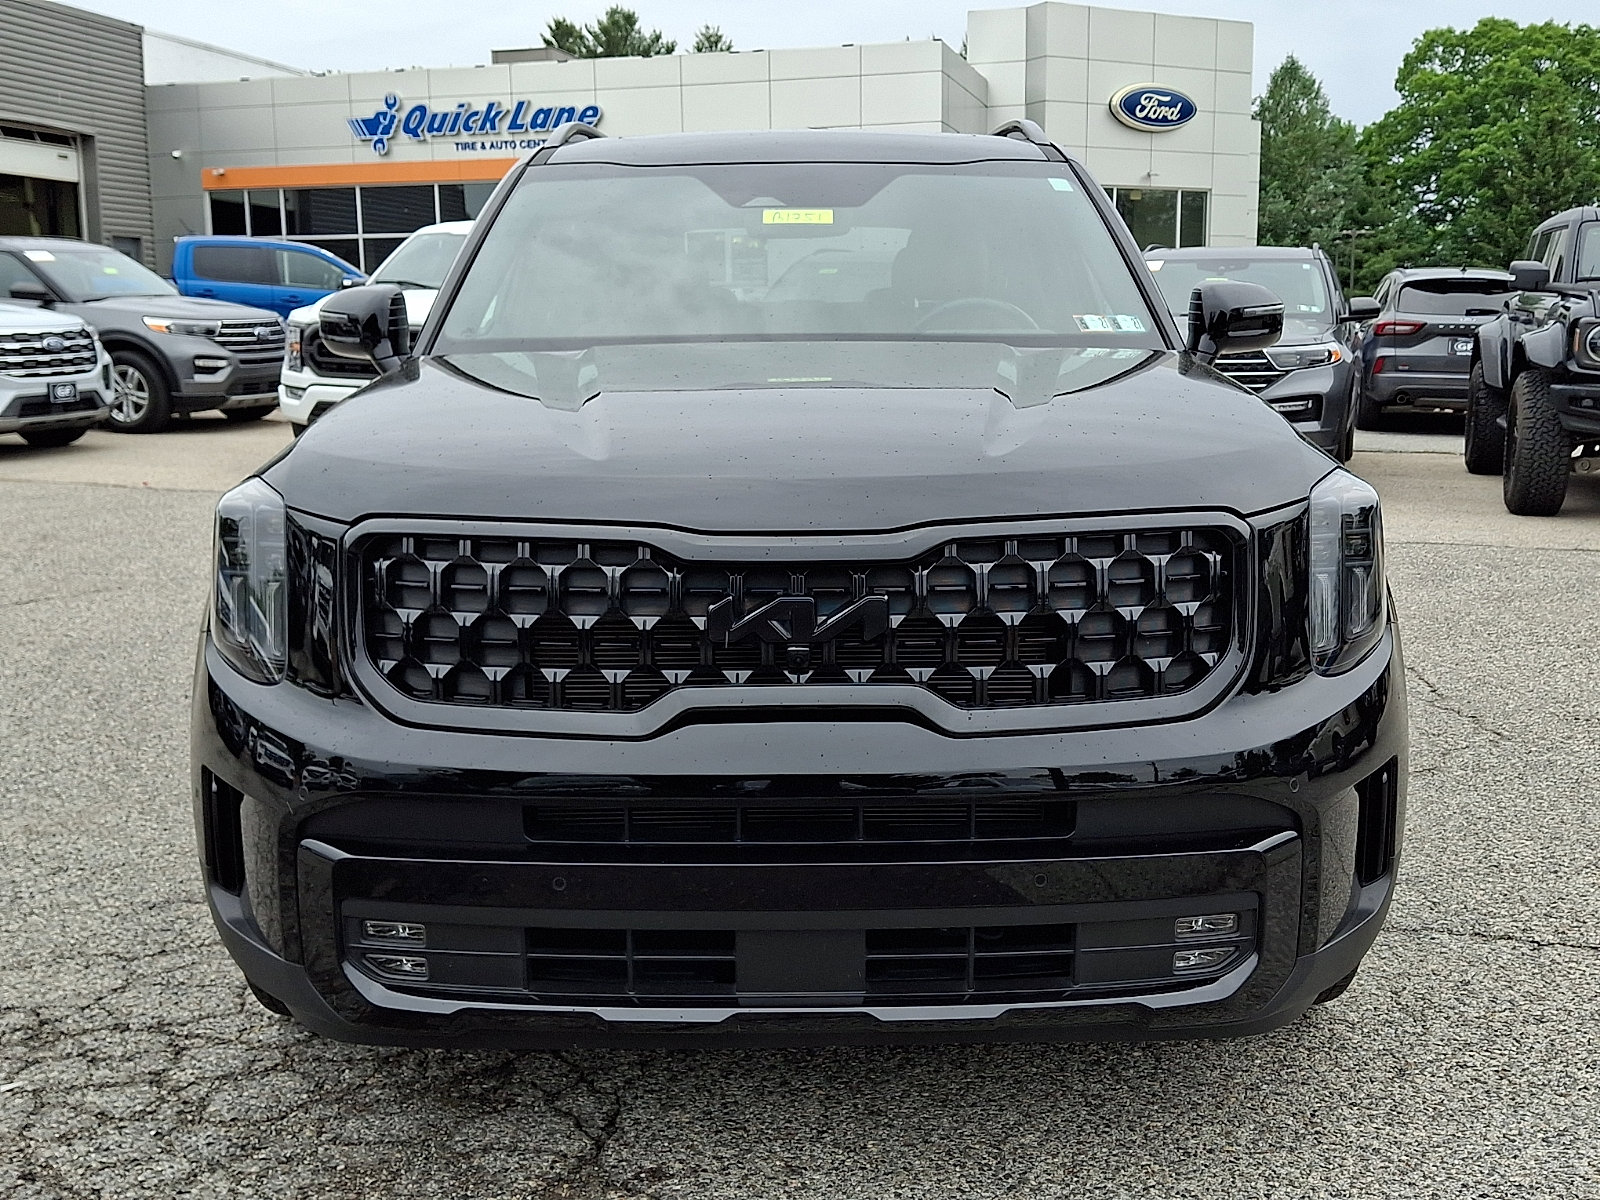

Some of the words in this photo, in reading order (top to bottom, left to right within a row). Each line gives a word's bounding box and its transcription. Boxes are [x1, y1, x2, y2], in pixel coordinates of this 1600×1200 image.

[401, 101, 506, 140] Quick
[507, 99, 601, 133] Lane
[1135, 92, 1183, 121] Ford
[455, 141, 478, 151] TIRE
[480, 141, 487, 150] &
[489, 140, 517, 150] AUTO
[519, 138, 548, 149] CENT
